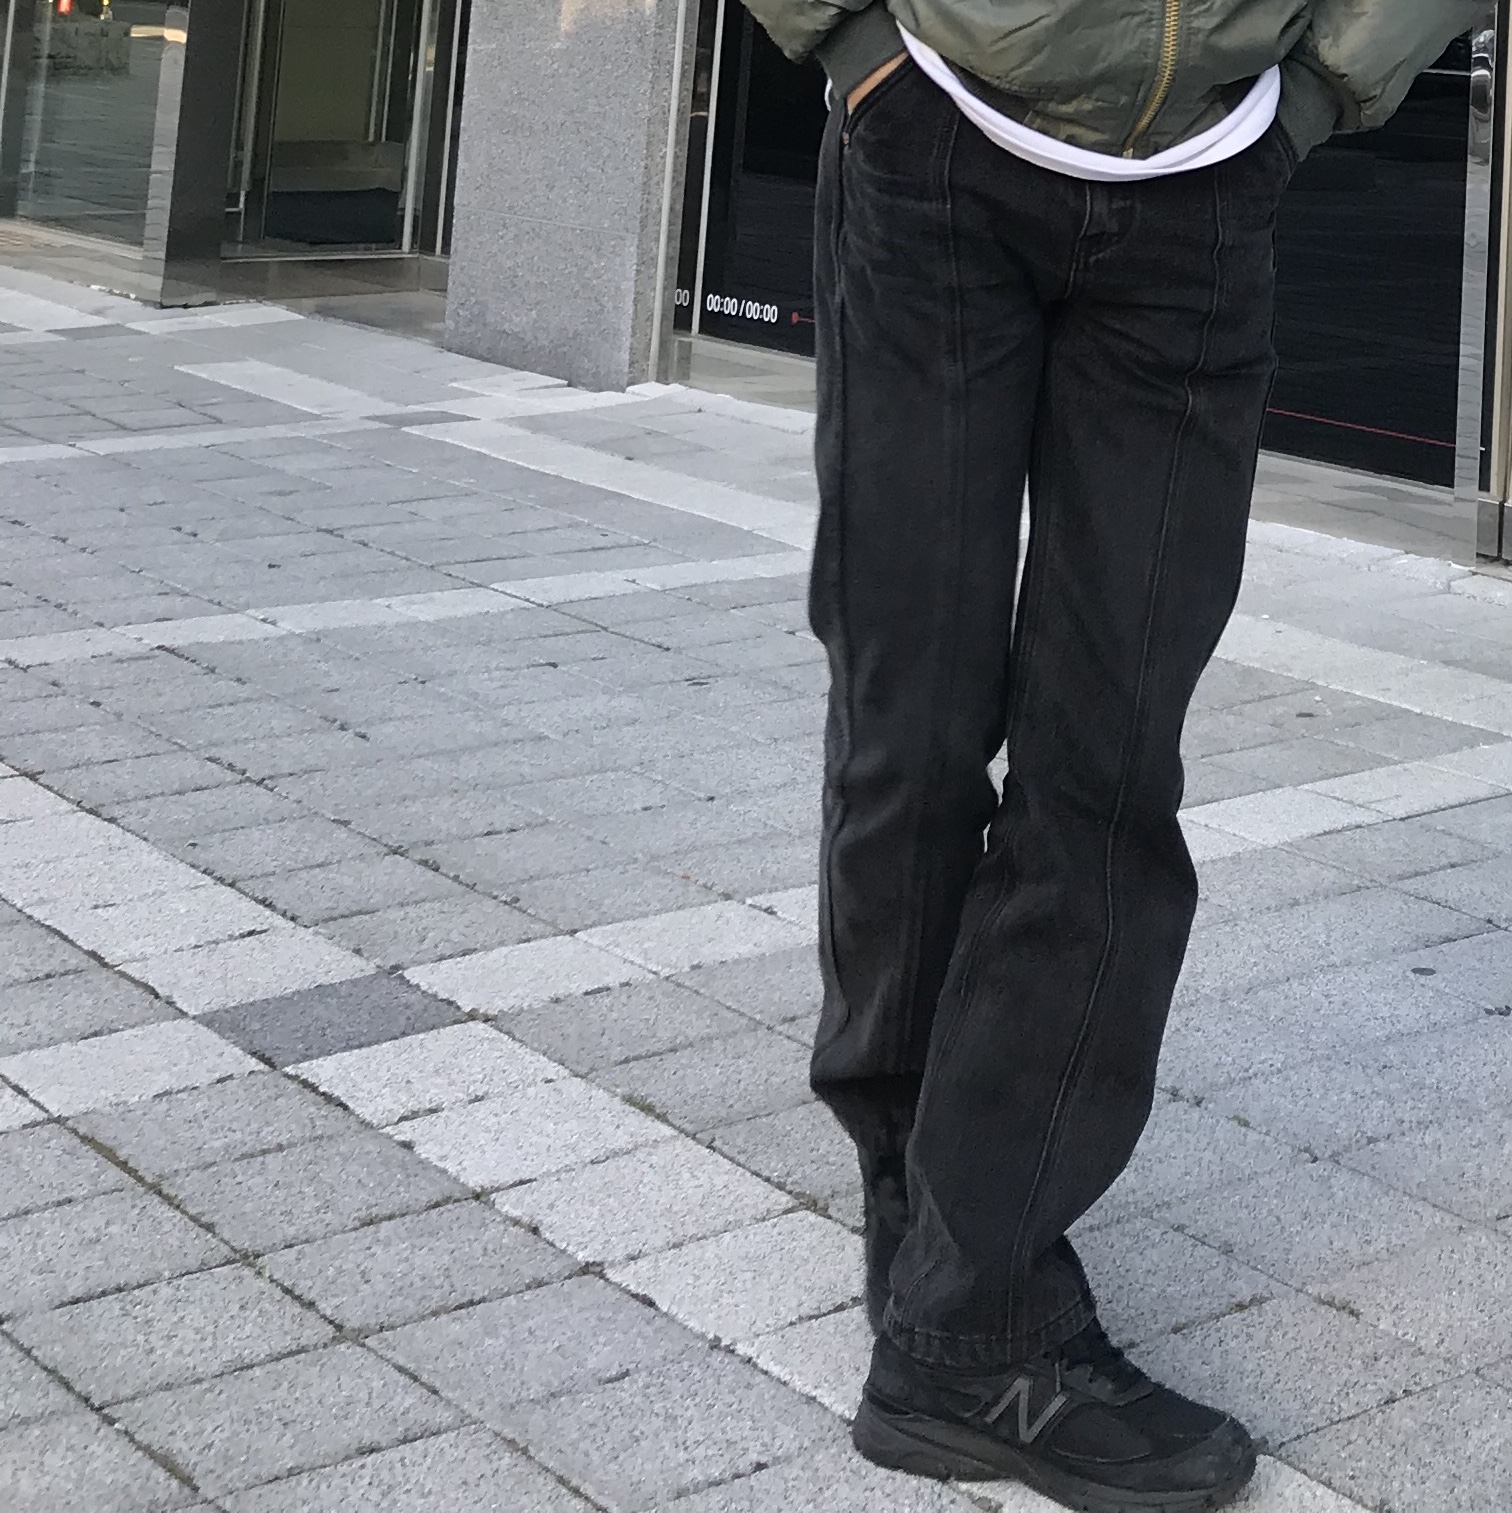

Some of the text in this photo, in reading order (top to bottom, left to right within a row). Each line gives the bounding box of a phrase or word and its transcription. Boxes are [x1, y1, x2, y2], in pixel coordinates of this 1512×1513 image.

[706, 293, 738, 316] 00:00
[745, 300, 778, 323] 00:00
[984, 1377, 1066, 1444] N
